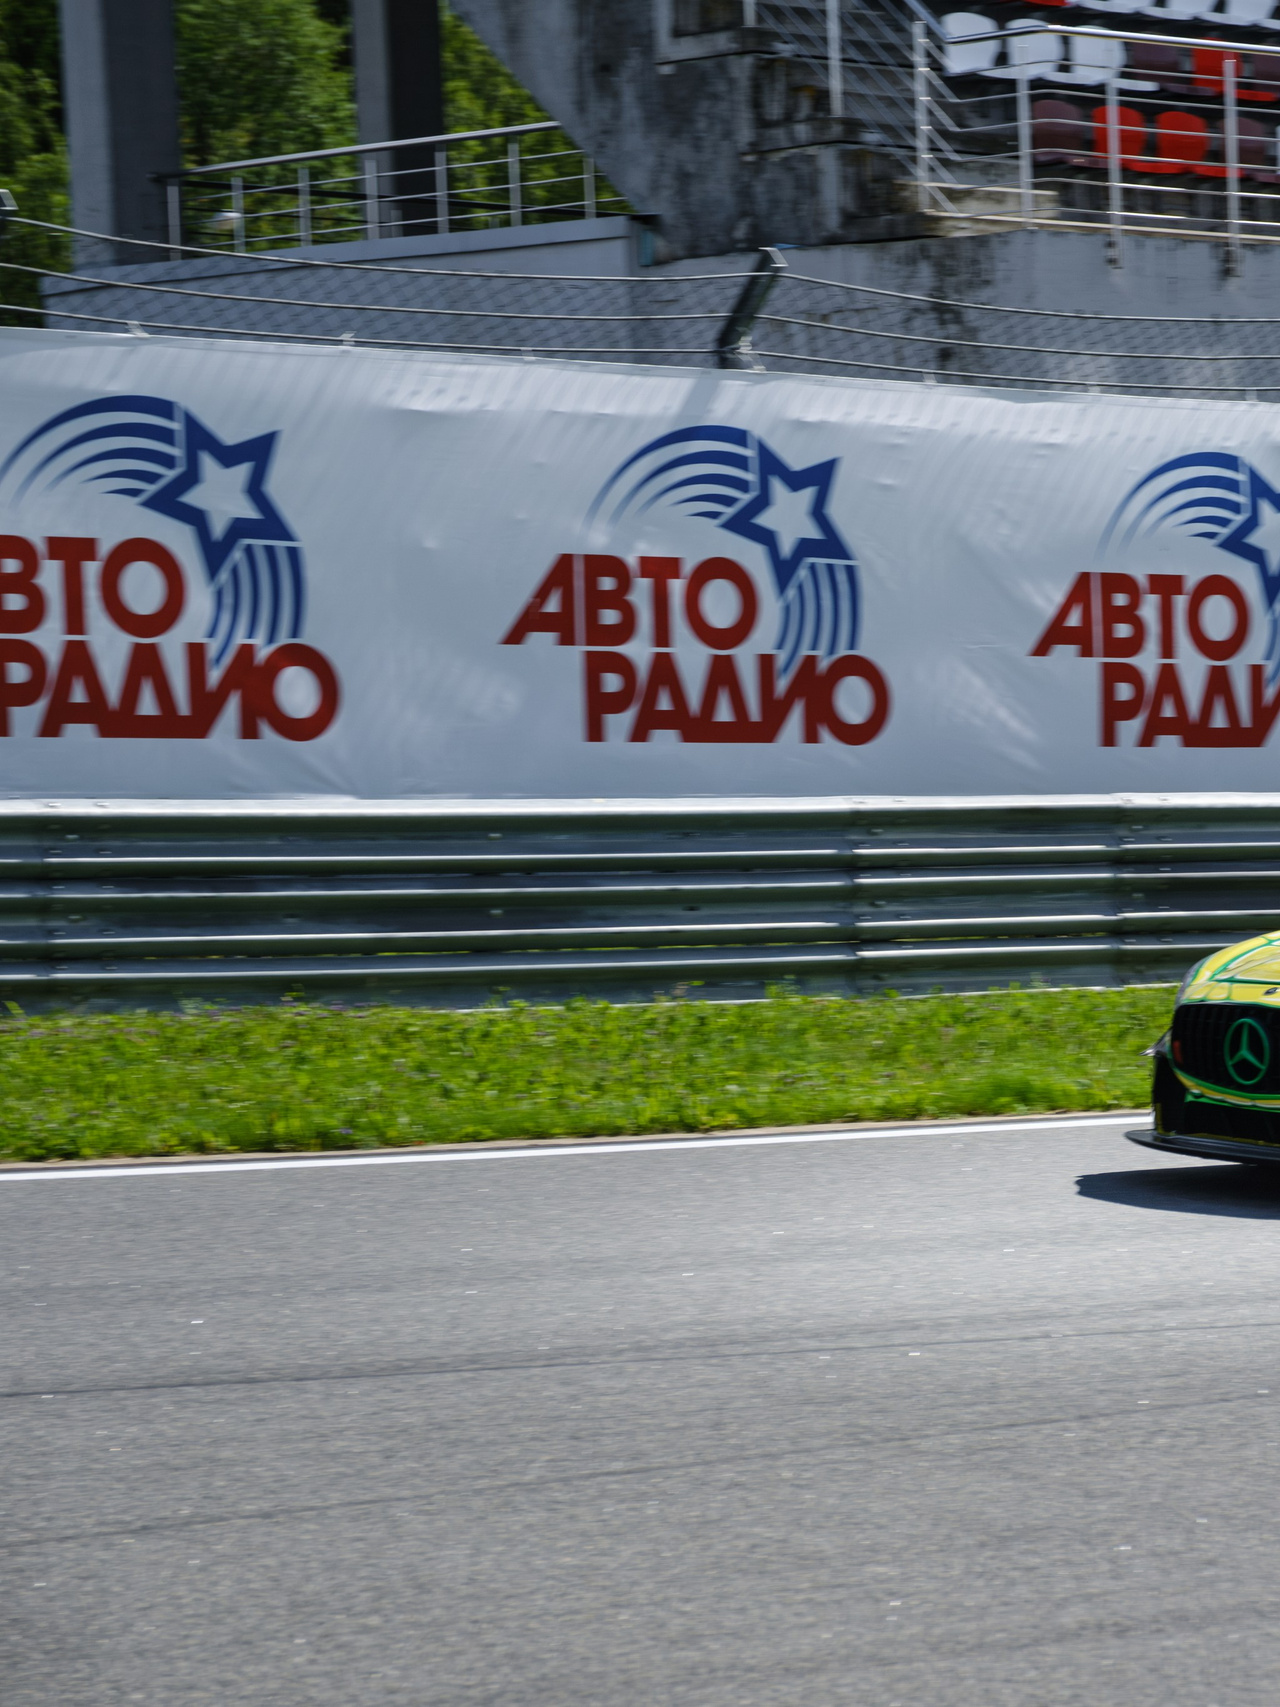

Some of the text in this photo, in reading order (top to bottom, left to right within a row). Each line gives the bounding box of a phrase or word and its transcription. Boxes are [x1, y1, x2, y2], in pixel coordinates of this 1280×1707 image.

[500, 553, 759, 648] АВТО
[1026, 572, 1251, 661] АВТО
[0, 638, 340, 741] РАДИО
[584, 650, 889, 745] РАДИО
